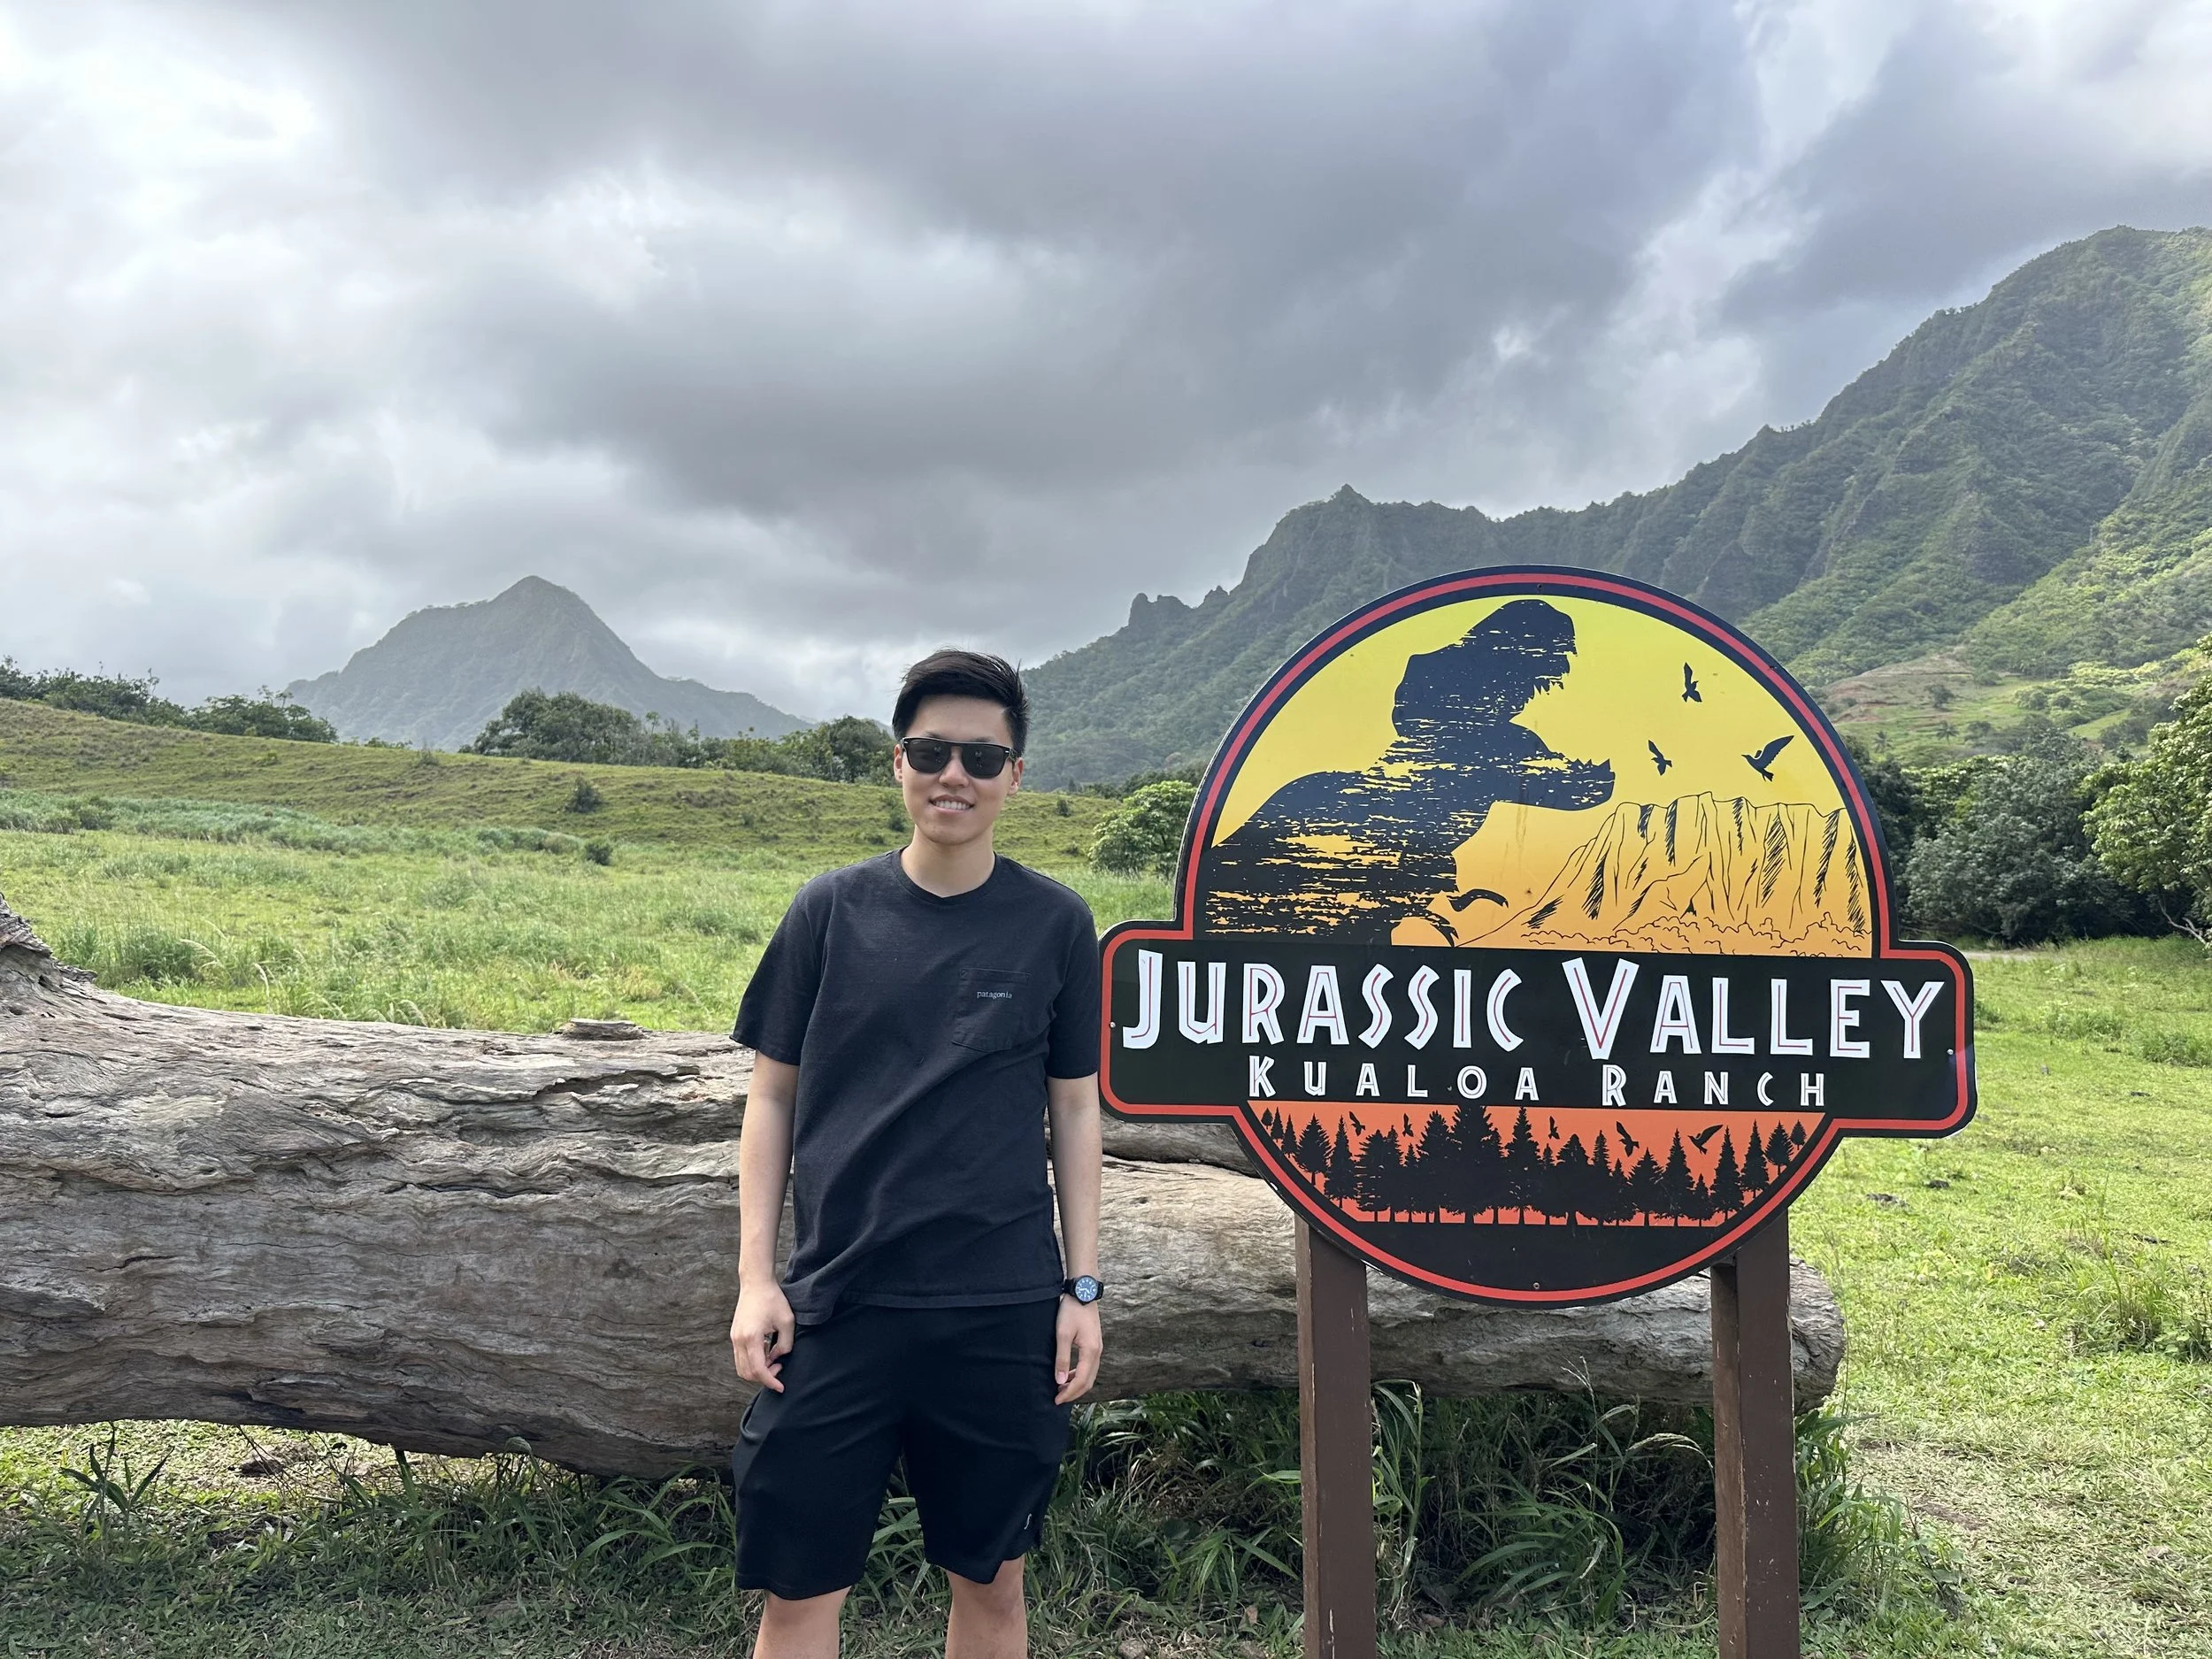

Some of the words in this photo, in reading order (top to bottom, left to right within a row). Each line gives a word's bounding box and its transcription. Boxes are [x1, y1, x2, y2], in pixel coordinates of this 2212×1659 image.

[976, 991, 1013, 1000] patagonia
[1122, 949, 1524, 1052] JURASSIC
[1561, 956, 1945, 1060] VALLEY
[1248, 1055, 1540, 1101] KUALOA
[1601, 1064, 1824, 1107] RANCH
